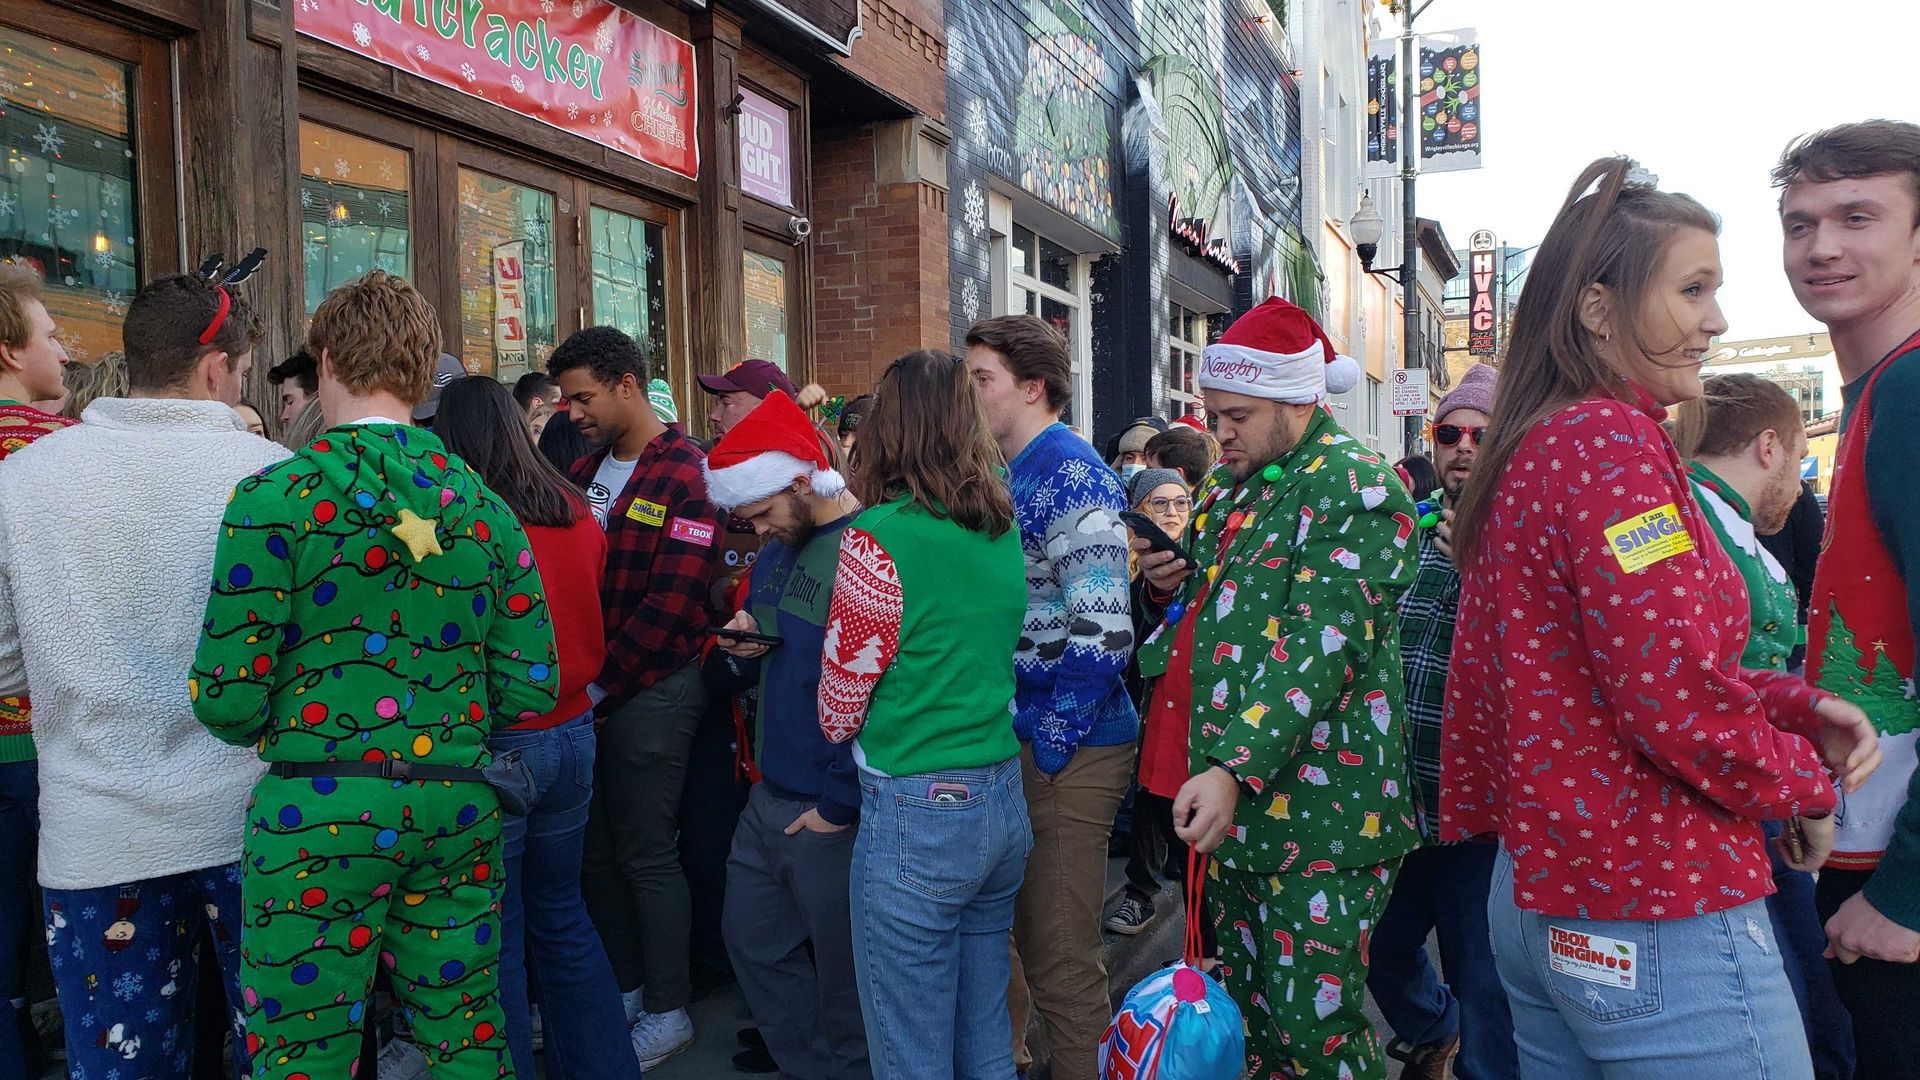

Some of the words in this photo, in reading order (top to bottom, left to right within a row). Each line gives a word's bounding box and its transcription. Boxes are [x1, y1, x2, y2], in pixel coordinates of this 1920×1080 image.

[355, 0, 604, 100] cracker
[631, 111, 687, 150] CHEER
[742, 143, 781, 184] GHT
[1473, 254, 1494, 331] HVAC
[1202, 355, 1262, 383] Naughty
[632, 502, 663, 518] SINGLE
[1648, 512, 1664, 521] am
[688, 527, 712, 540] TBOX
[1615, 514, 1684, 553] SINGL
[1550, 927, 1591, 949] TBOX
[1550, 940, 1604, 966] VIRGIN
